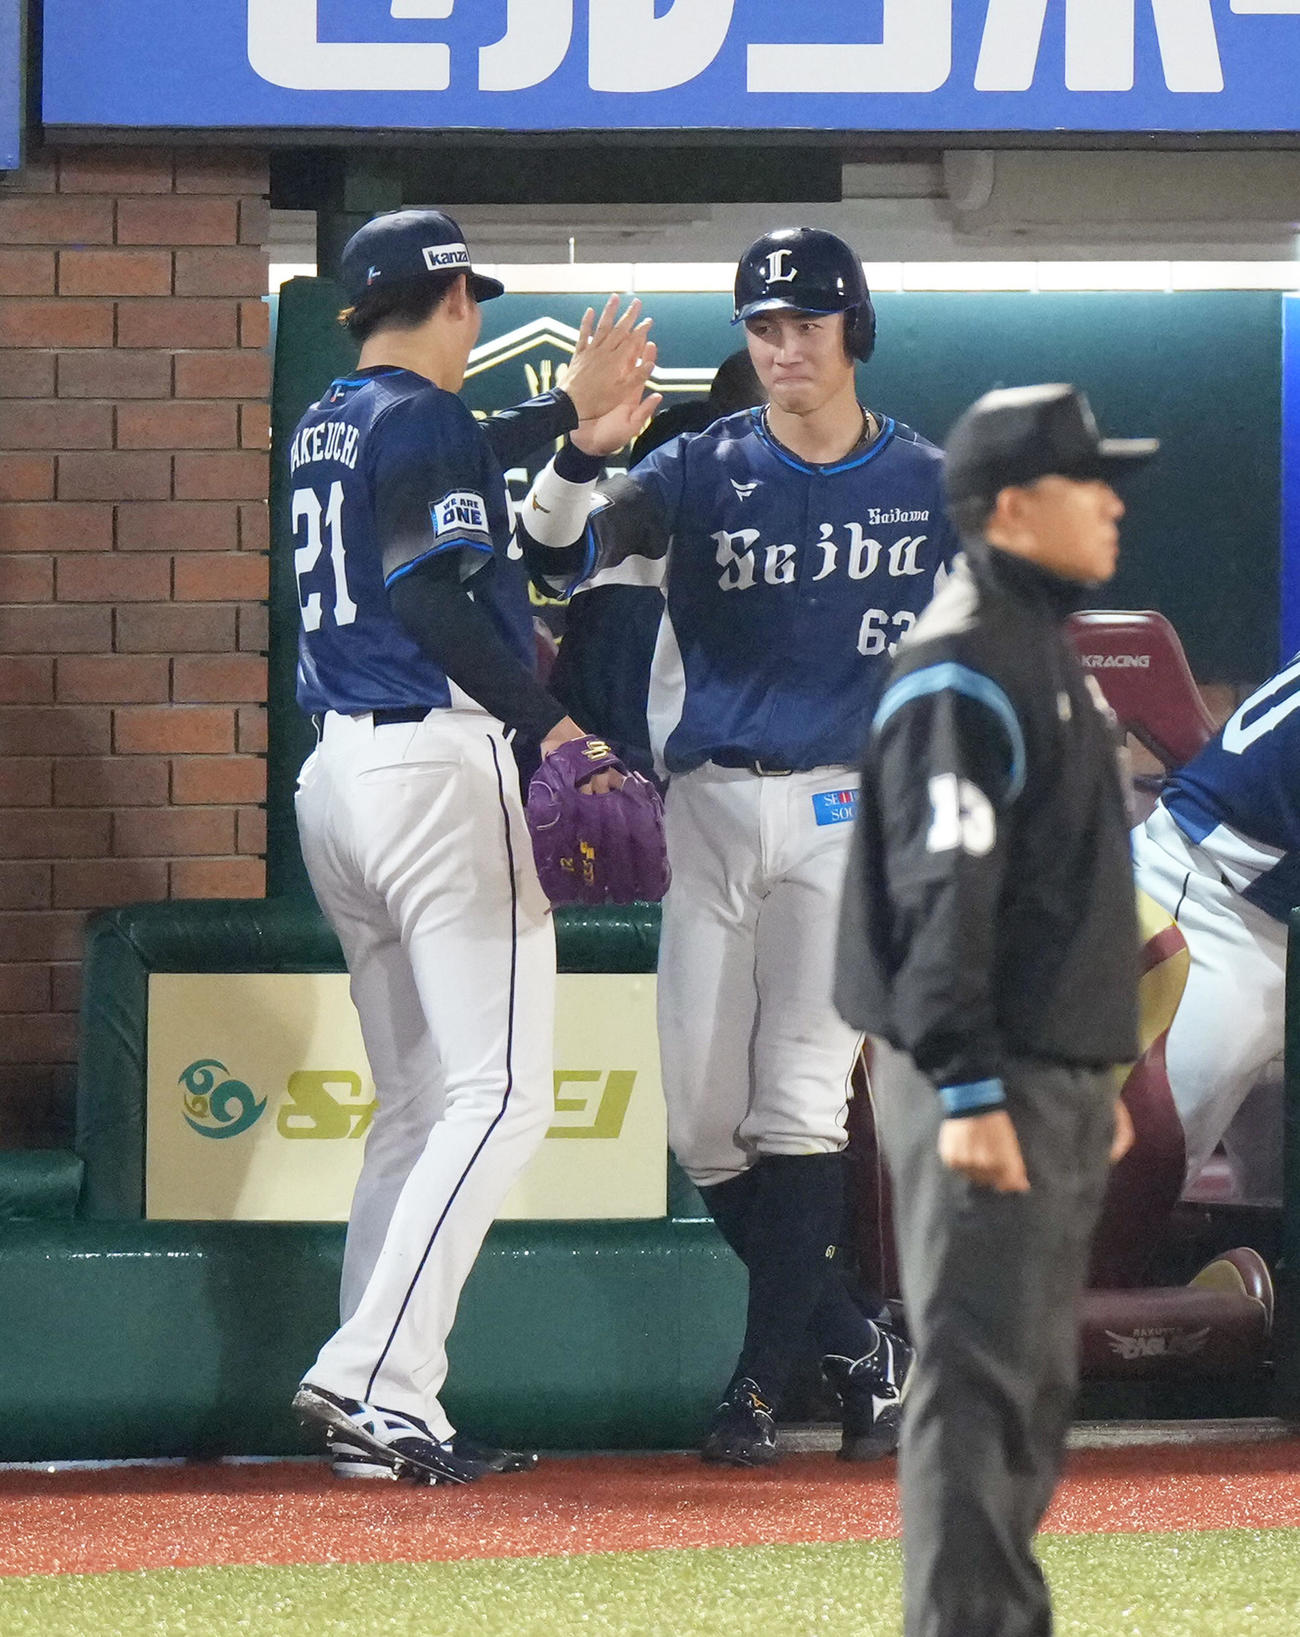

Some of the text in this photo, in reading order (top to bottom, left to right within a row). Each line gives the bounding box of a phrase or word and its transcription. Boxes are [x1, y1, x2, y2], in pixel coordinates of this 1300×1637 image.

[765, 249, 798, 284] L
[290, 422, 360, 478] AKEUCHI
[443, 498, 479, 510] WE ARE
[443, 506, 482, 525] ONE
[291, 480, 357, 632] 21
[856, 607, 917, 659] 63
[1075, 654, 1152, 668] KRACING
